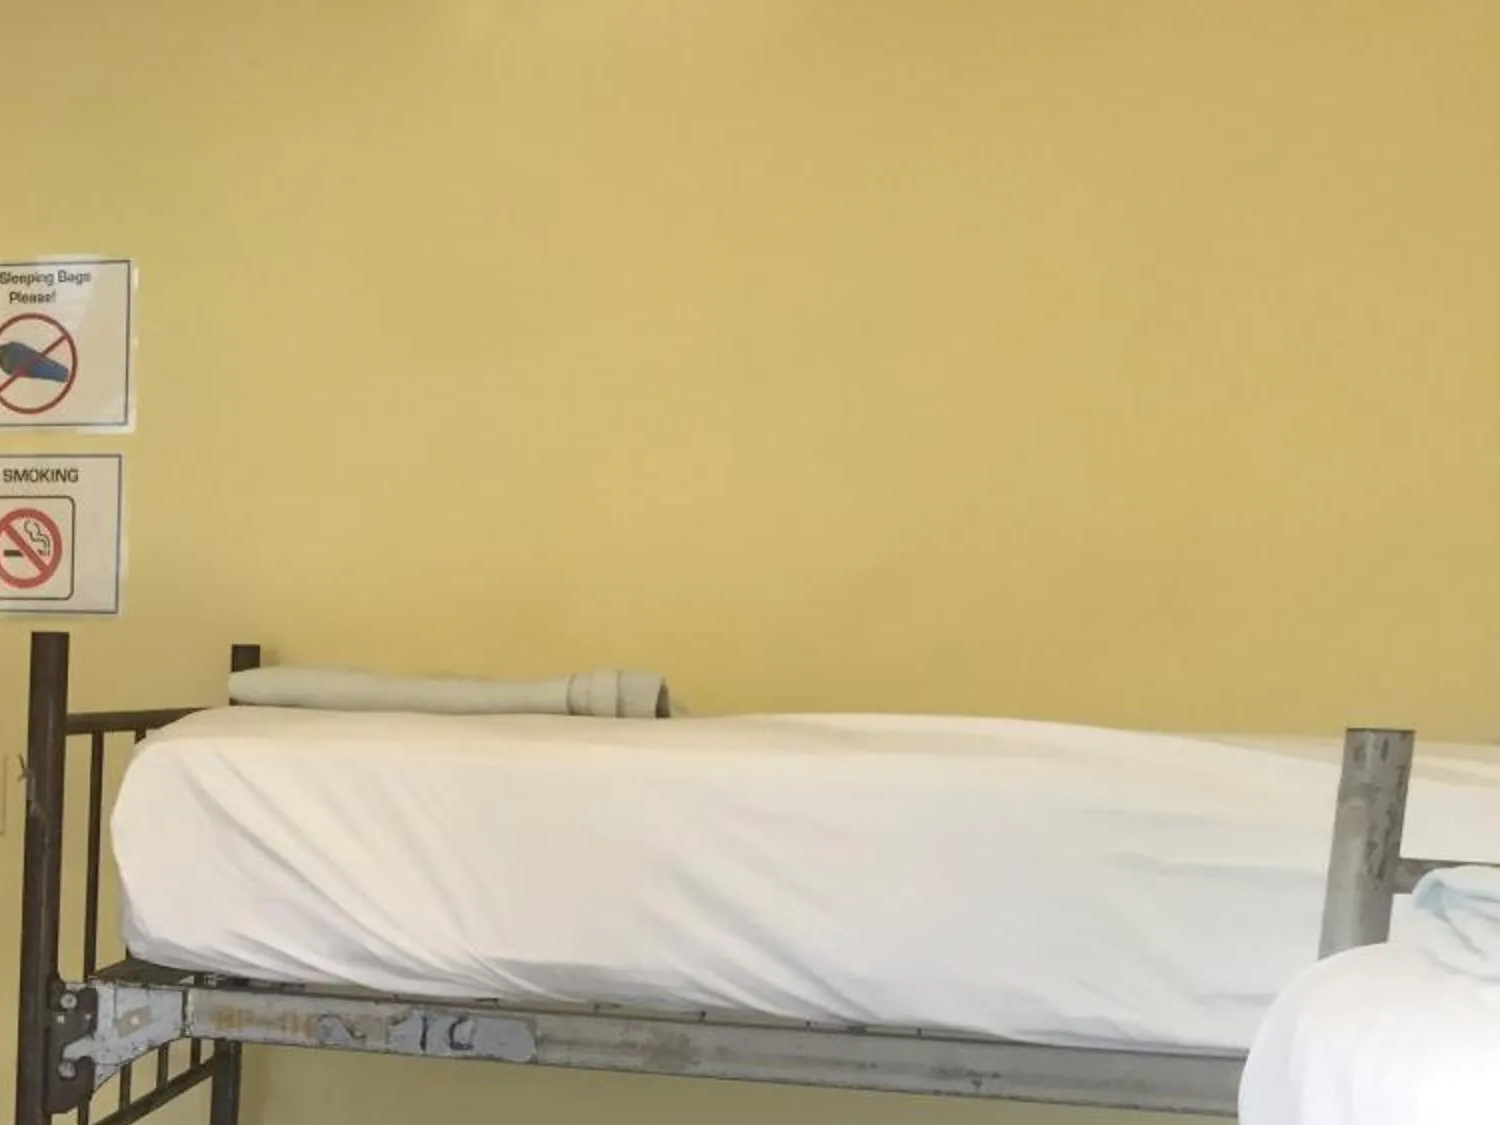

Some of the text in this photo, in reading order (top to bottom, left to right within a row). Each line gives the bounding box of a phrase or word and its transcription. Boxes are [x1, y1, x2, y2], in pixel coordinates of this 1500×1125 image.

[0, 271, 55, 287] Sleeping
[58, 269, 91, 285] Bags
[3, 467, 79, 483] SMOKING
